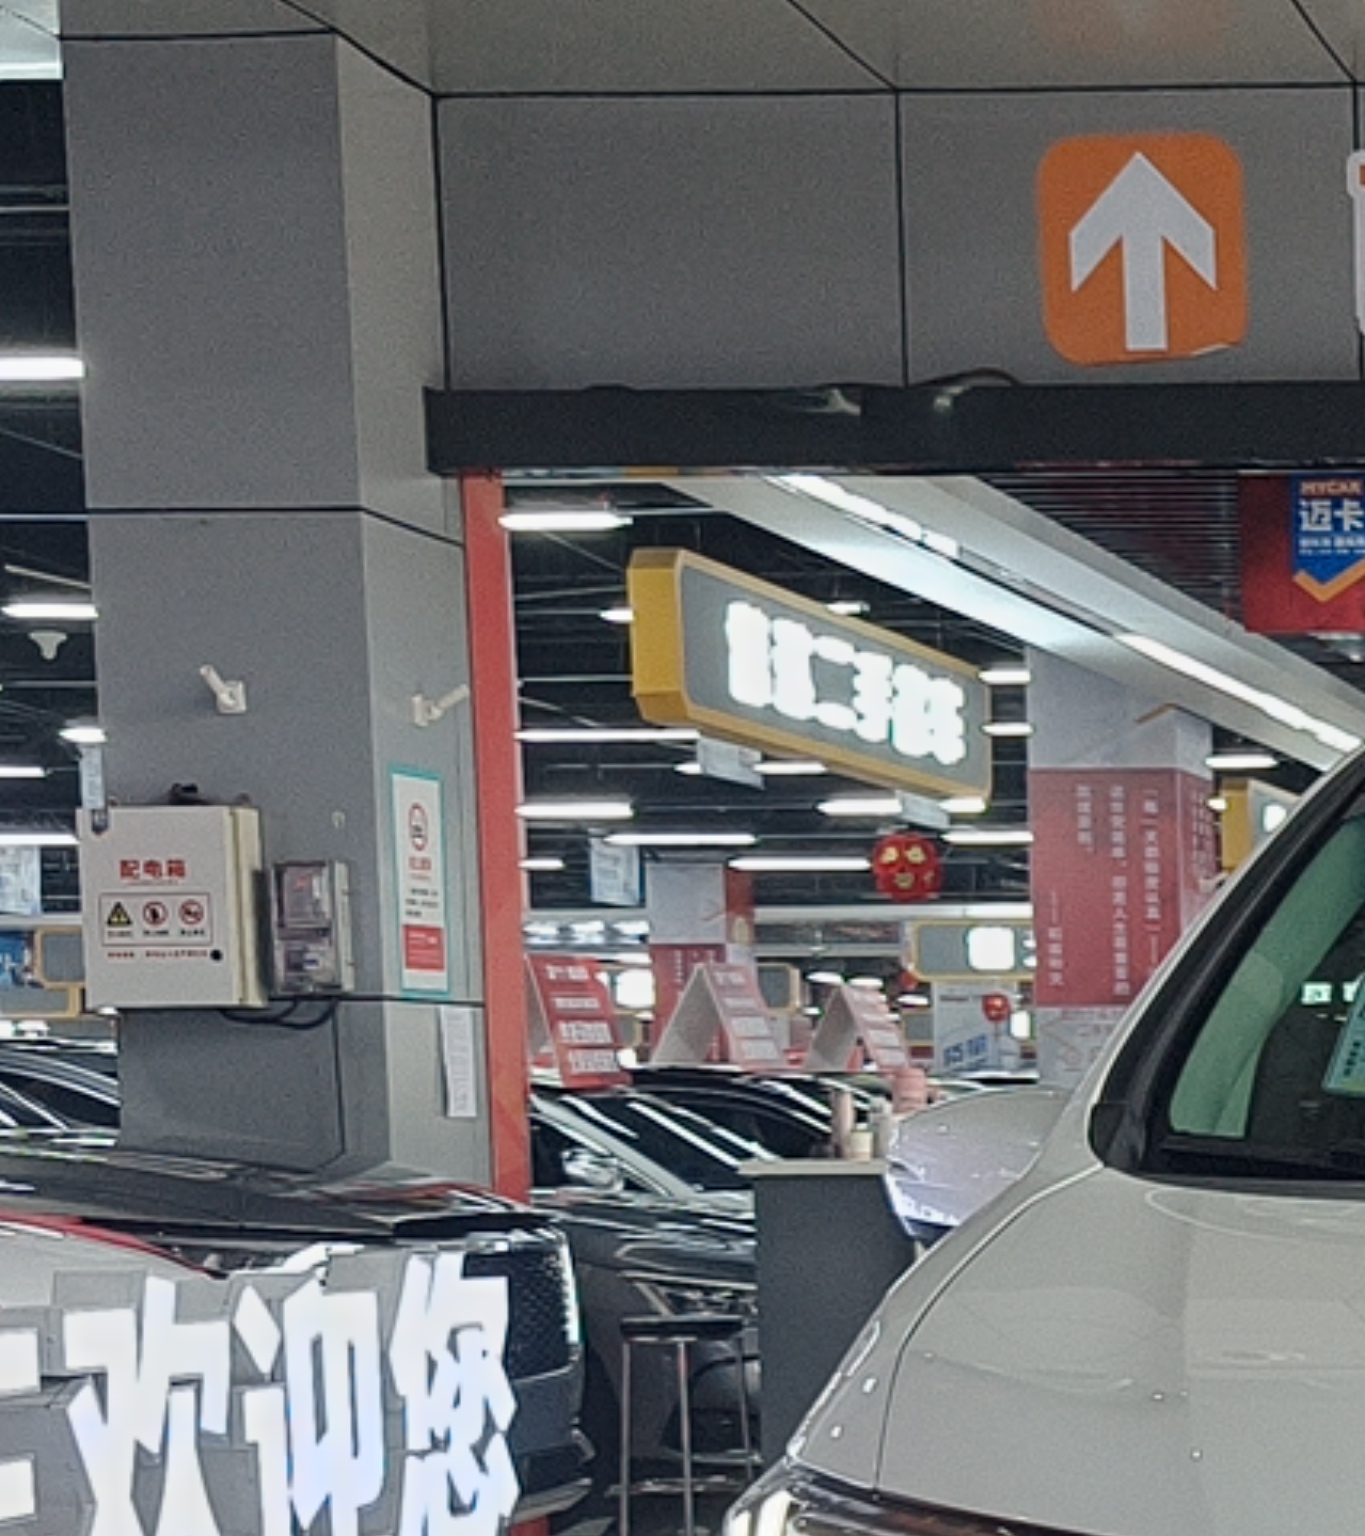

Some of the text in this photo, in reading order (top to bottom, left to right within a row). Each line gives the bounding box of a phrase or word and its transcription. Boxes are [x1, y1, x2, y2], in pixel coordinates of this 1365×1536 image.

[1299, 499, 1365, 532] 迈卡
[119, 859, 187, 879] 配电箱
